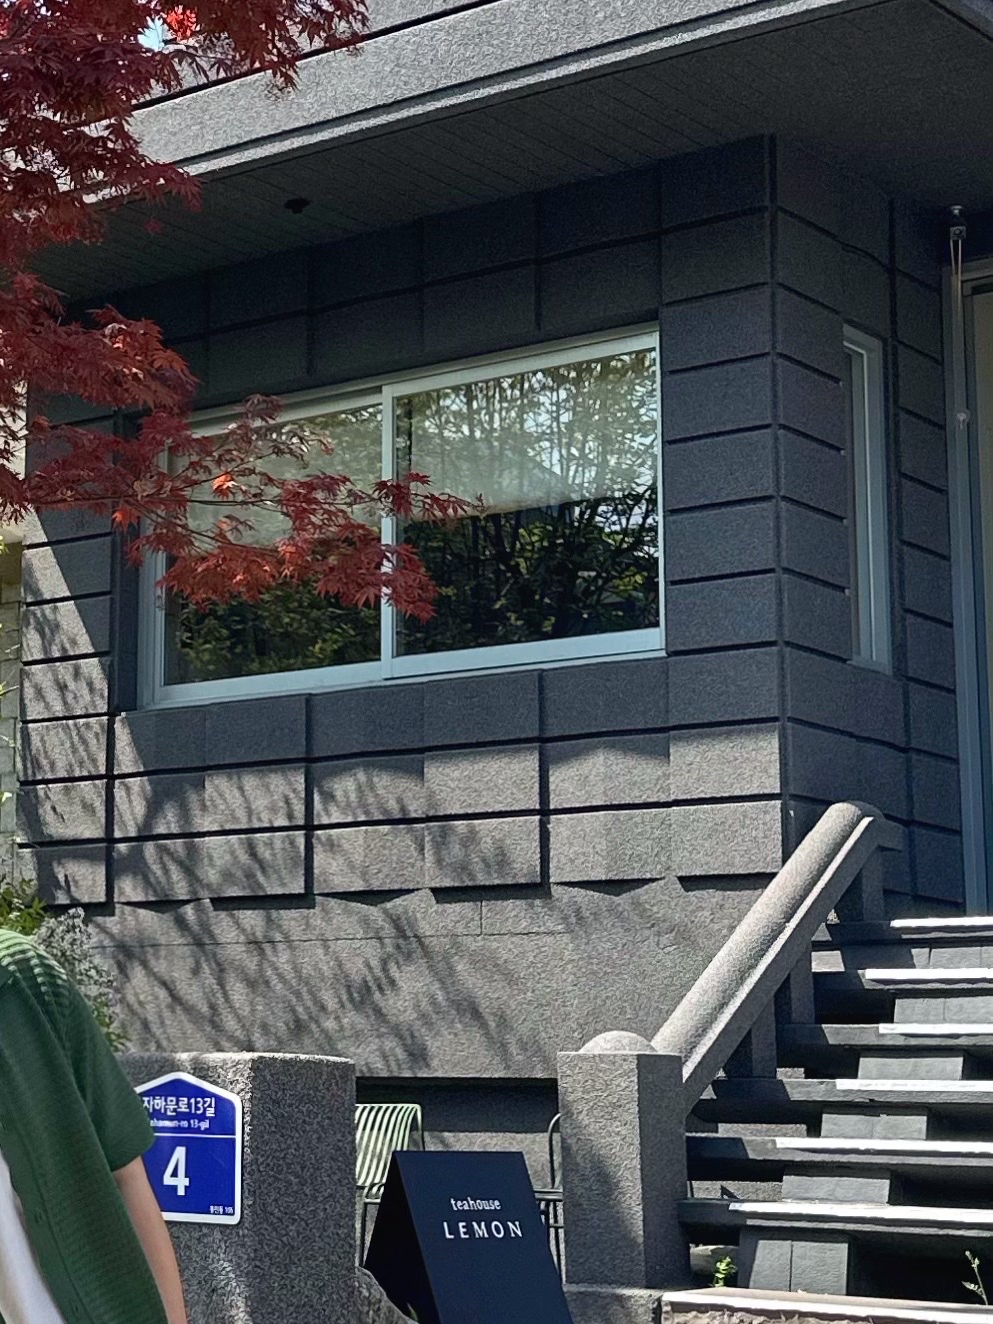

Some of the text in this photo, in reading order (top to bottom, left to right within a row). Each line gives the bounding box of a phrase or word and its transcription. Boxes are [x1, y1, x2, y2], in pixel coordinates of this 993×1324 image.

[142, 1096, 216, 1117] 자하문로13길
[163, 1146, 190, 1196] 4
[450, 1196, 502, 1211] teahouse
[443, 1220, 523, 1239] LEMON
